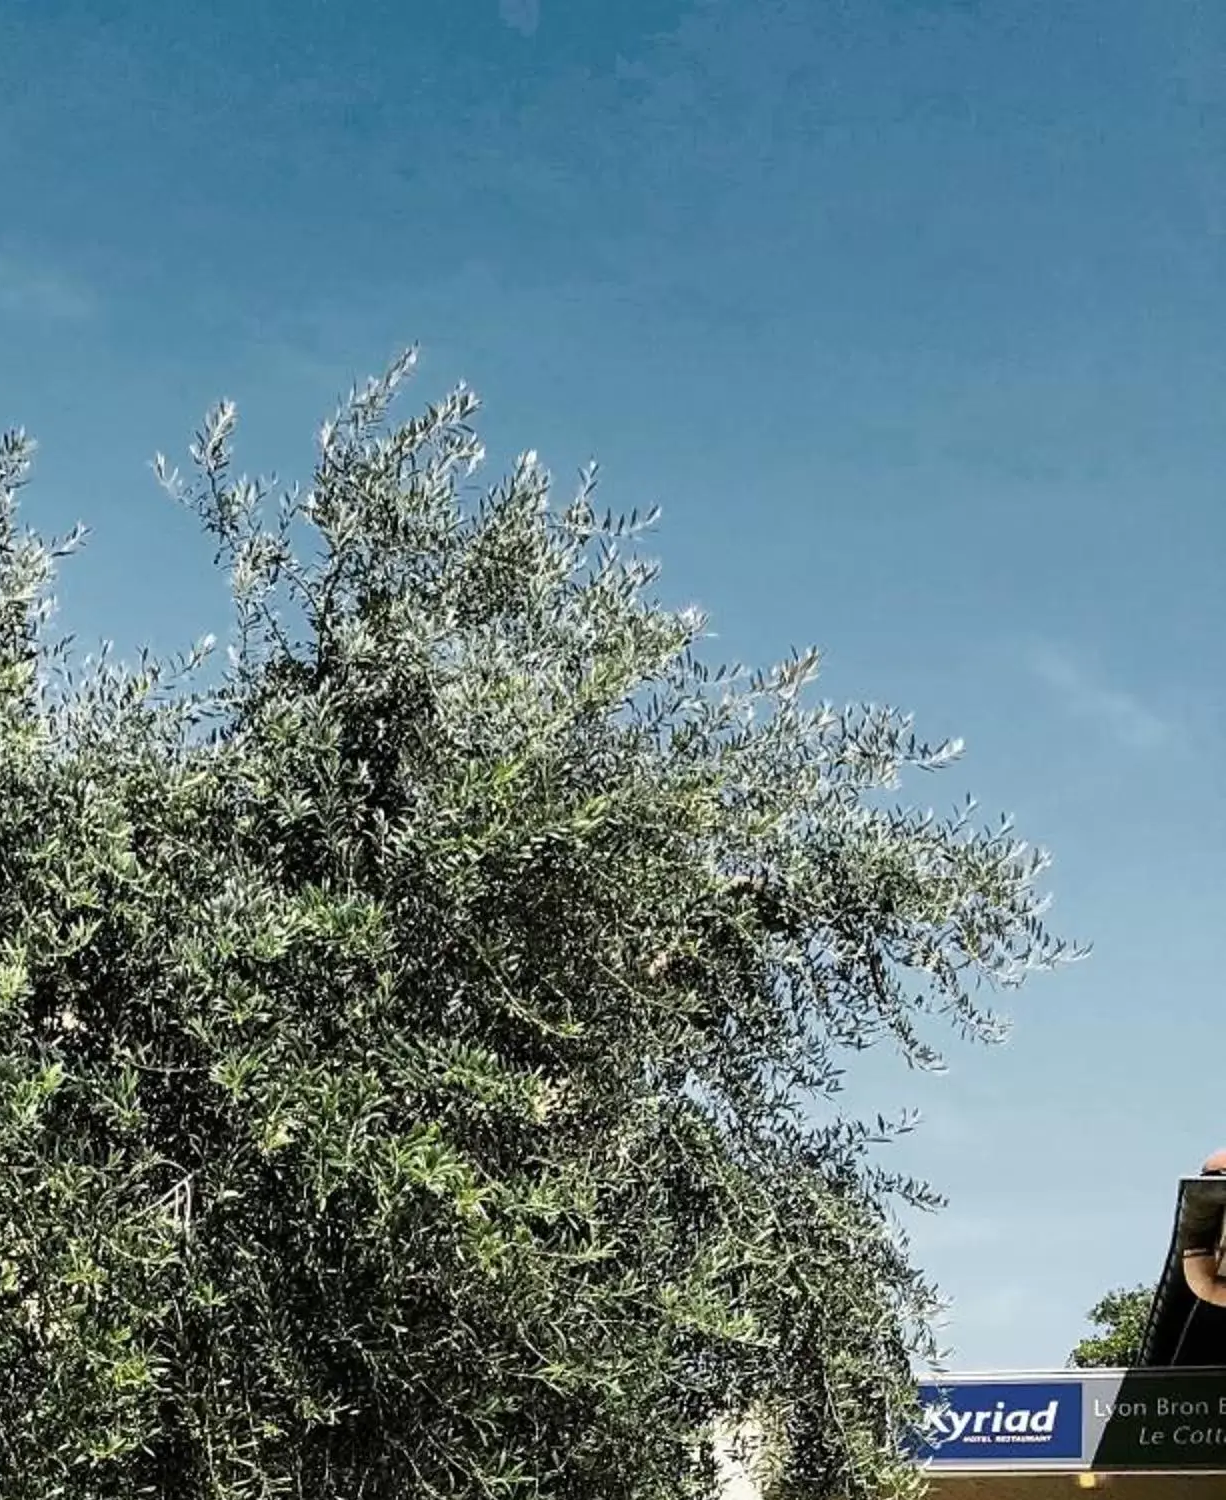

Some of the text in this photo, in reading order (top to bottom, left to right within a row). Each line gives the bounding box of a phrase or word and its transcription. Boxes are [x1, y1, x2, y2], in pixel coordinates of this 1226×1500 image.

[1094, 1398, 1148, 1420] Lyon
[1156, 1396, 1210, 1416] Bron
[924, 1400, 1059, 1442] Kyriad
[962, 1434, 1053, 1443] HOTEL RESTAURANT
[1138, 1424, 1226, 1446] Le Cott
